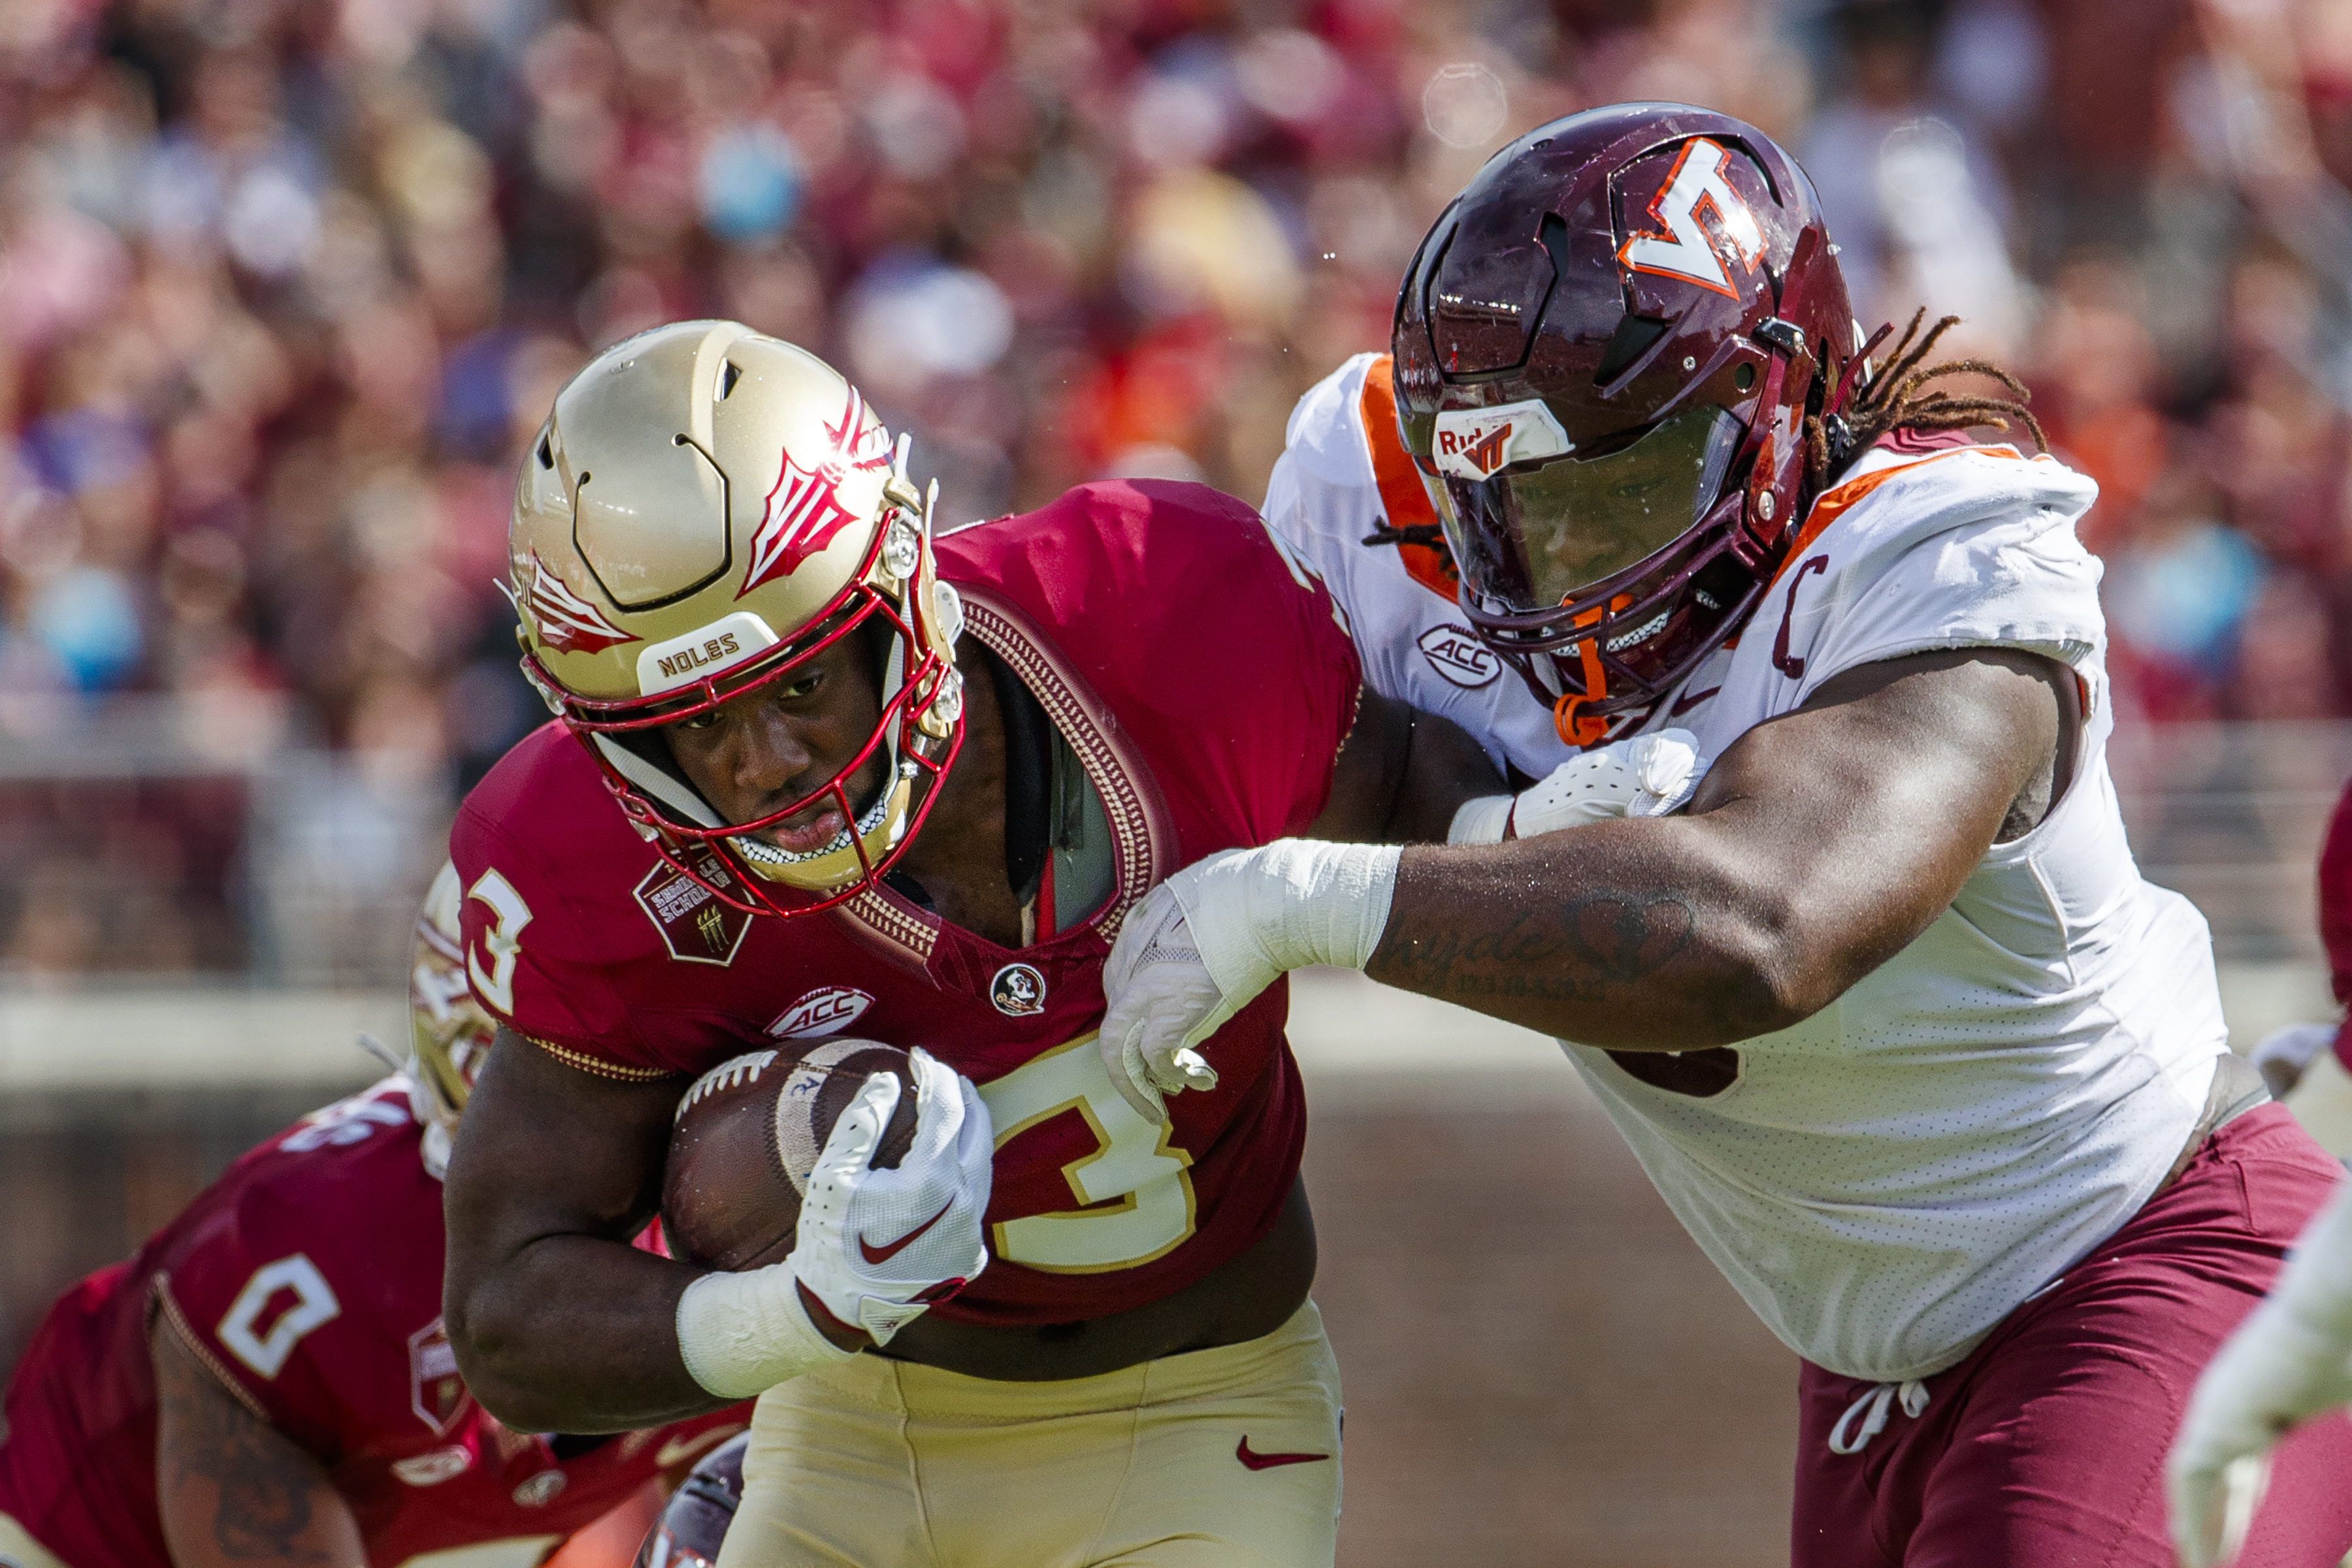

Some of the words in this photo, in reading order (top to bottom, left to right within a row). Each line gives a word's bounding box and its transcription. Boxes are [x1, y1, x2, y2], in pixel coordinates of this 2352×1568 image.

[1618, 137, 1769, 302] VT
[1463, 422, 1512, 475] VT
[657, 632, 740, 678] NOLES
[1431, 638, 1492, 670] ACC
[1772, 554, 1829, 679] C
[651, 858, 722, 909] SEMINLE
[467, 866, 532, 1017] 3
[782, 992, 855, 1033] ACC
[979, 1028, 1198, 1275] 3
[216, 1252, 341, 1380] 0
